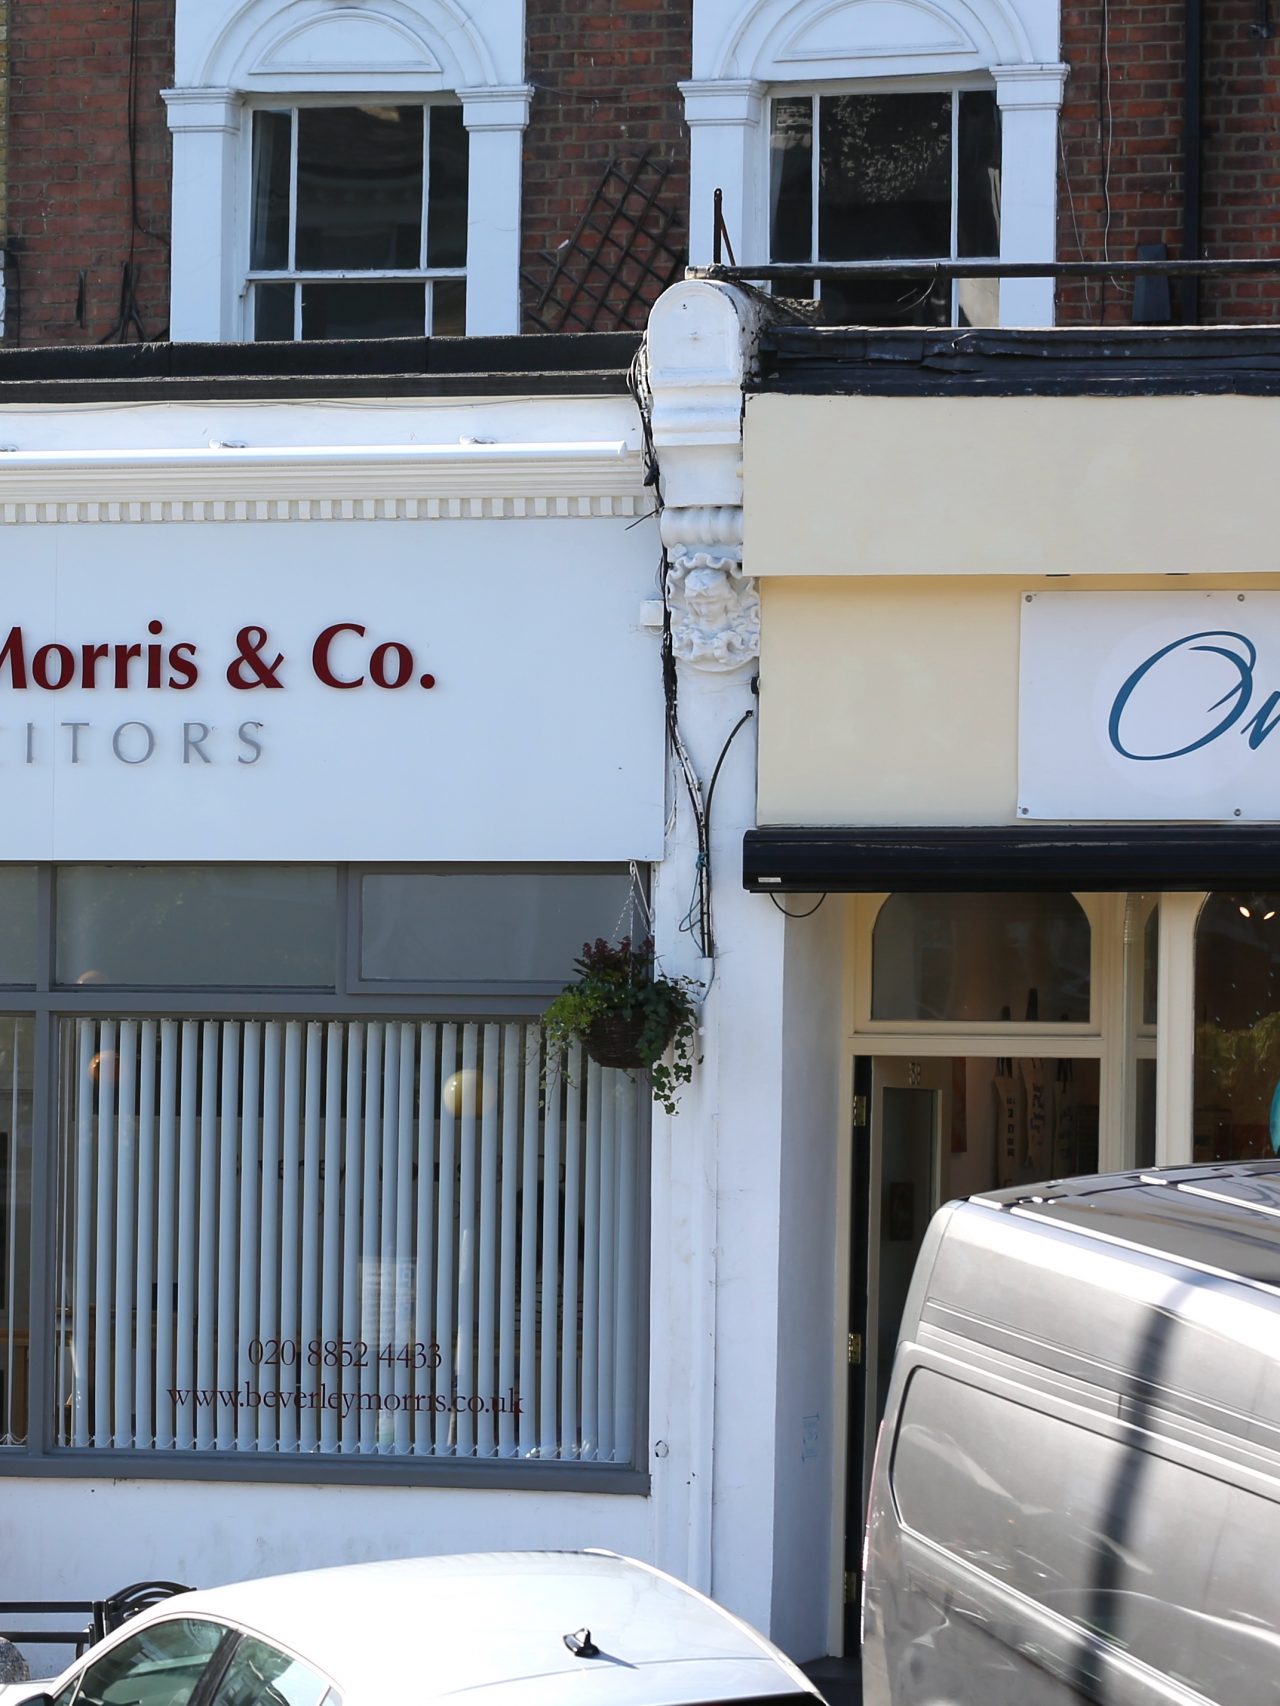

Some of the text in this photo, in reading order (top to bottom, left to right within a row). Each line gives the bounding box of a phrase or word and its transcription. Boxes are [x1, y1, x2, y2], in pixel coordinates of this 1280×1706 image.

[226, 625, 285, 691] &
[311, 622, 437, 690] Co.
[248, 1338, 442, 1369] 020 8852 4433
[167, 1381, 525, 1418] www.beverleymorris.co.uk
